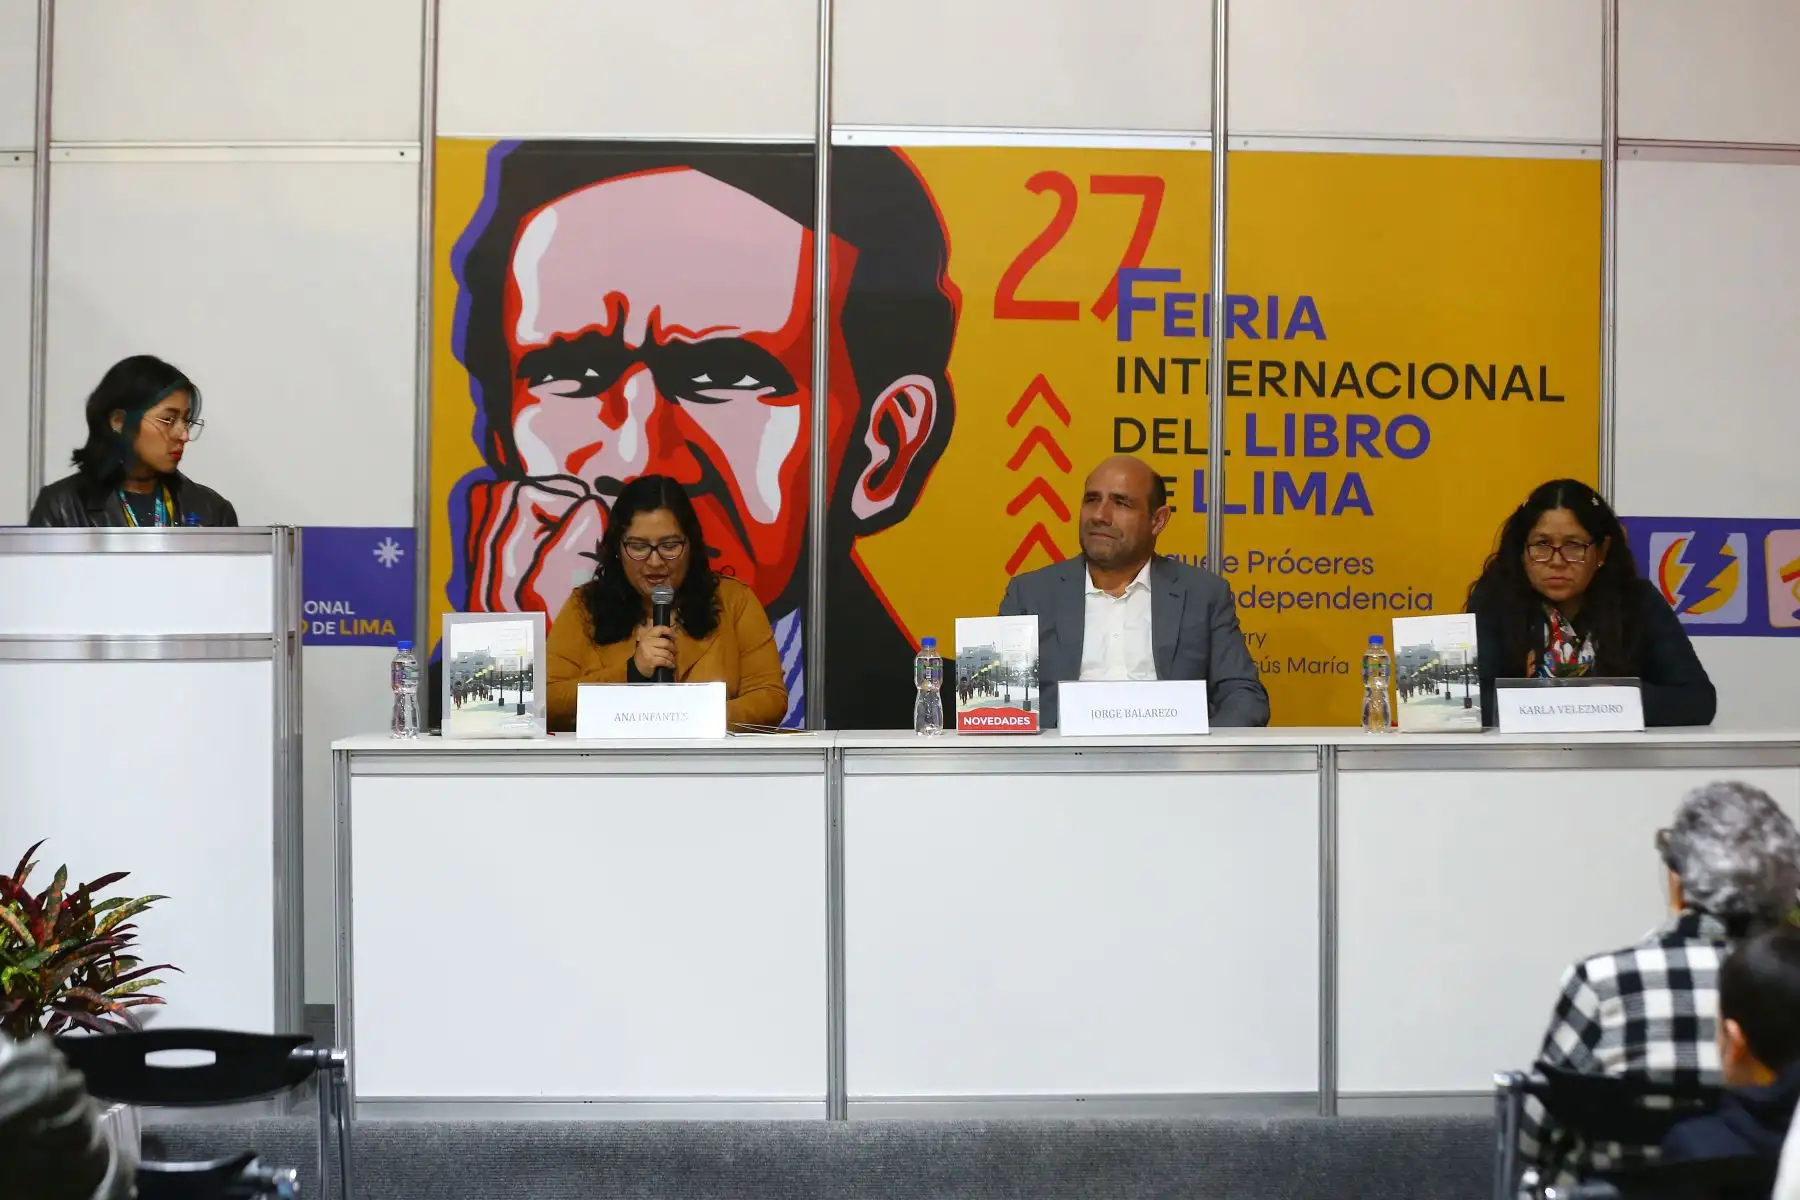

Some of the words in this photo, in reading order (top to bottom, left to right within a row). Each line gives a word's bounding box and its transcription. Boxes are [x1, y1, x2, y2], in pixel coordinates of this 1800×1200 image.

[994, 170, 1166, 321] 27
[1113, 416, 1231, 456] DEL
[1245, 412, 1431, 459] LIBRO
[1248, 547, 1374, 575] Próceres
[1231, 584, 1433, 614] dependencia
[312, 621, 337, 636] DE
[340, 619, 397, 636] LIMA
[1287, 655, 1350, 675] María
[614, 712, 637, 723] ANA
[638, 712, 690, 722] INFANTES
[1091, 709, 1123, 720] JORGE
[1124, 708, 1179, 719] BALAREZO
[1518, 705, 1556, 715] KARLA
[1556, 704, 1624, 715] VELEZMORO
[963, 716, 1031, 726] NOVEDADES
